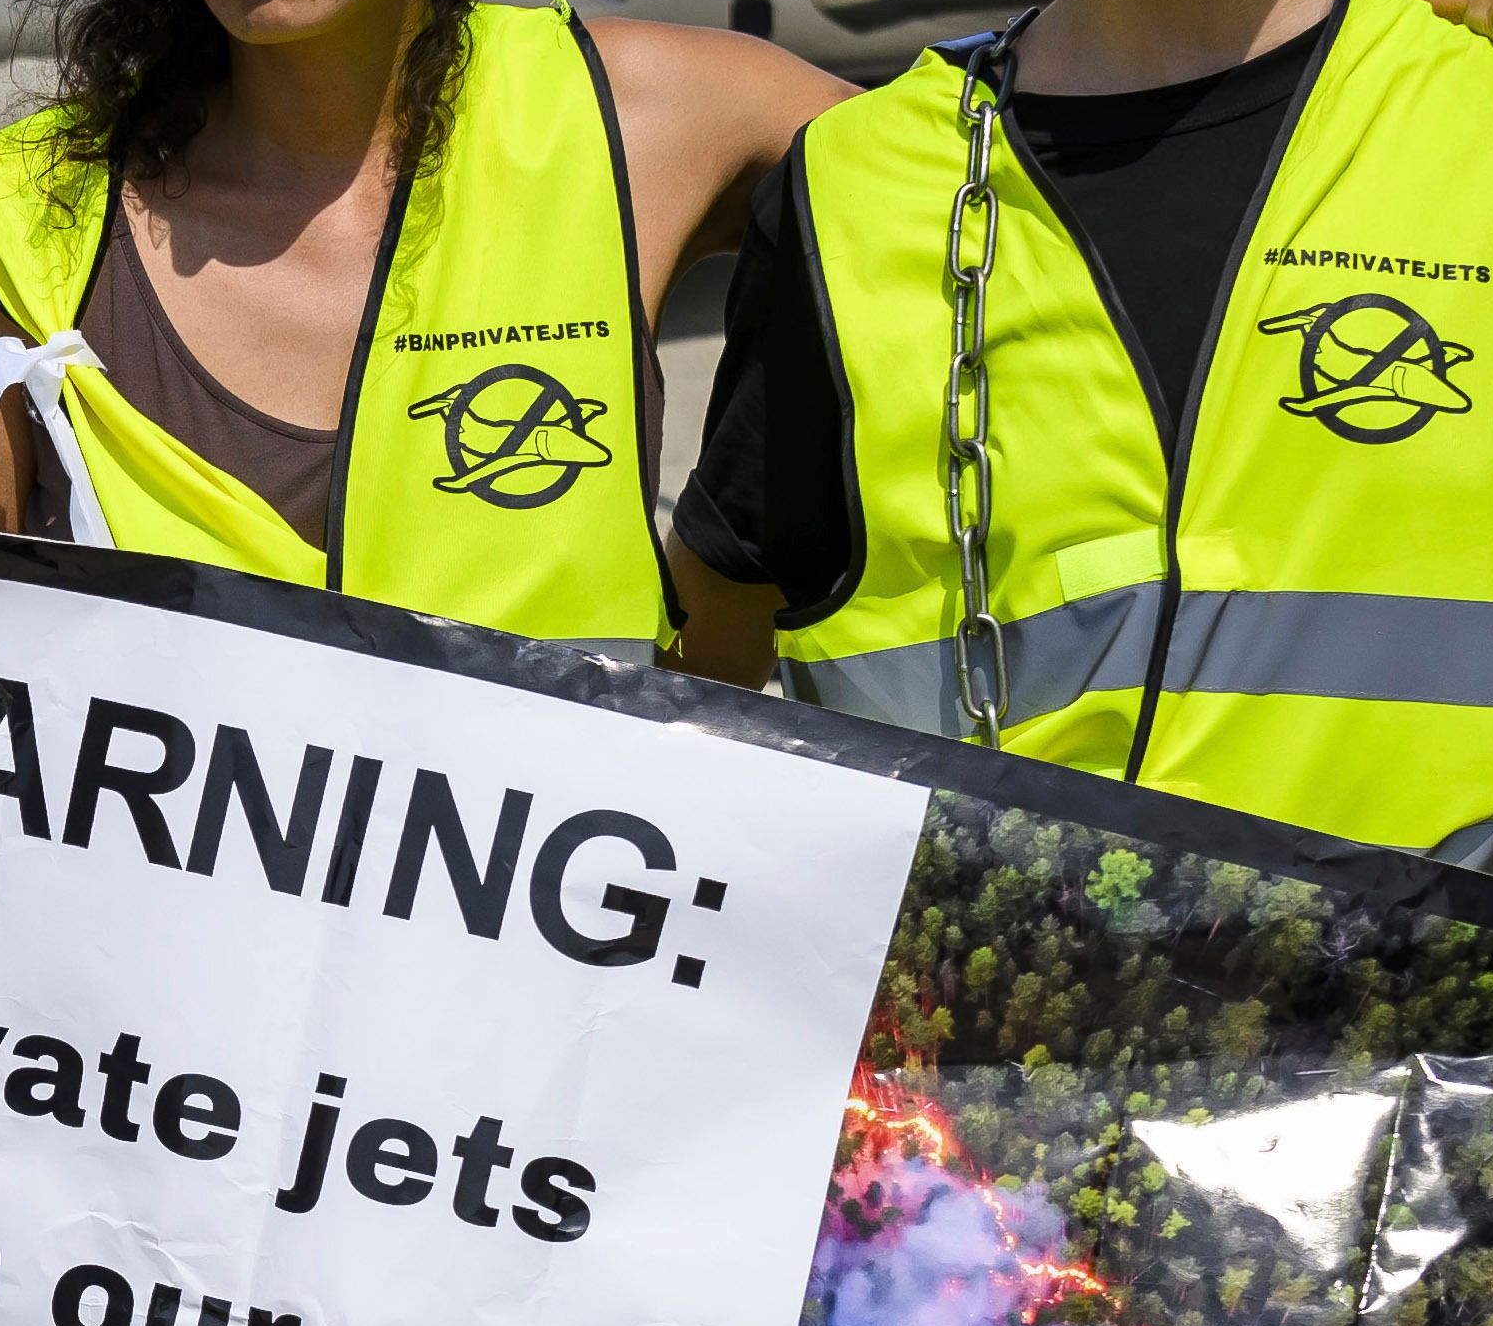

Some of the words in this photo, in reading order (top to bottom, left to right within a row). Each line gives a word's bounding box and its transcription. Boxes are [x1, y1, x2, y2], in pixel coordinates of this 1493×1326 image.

[1263, 247, 1491, 284] #ANPRIVATEJETS
[393, 320, 610, 353] #BANPRIVATEJETS
[274, 1073, 597, 1243] jets
